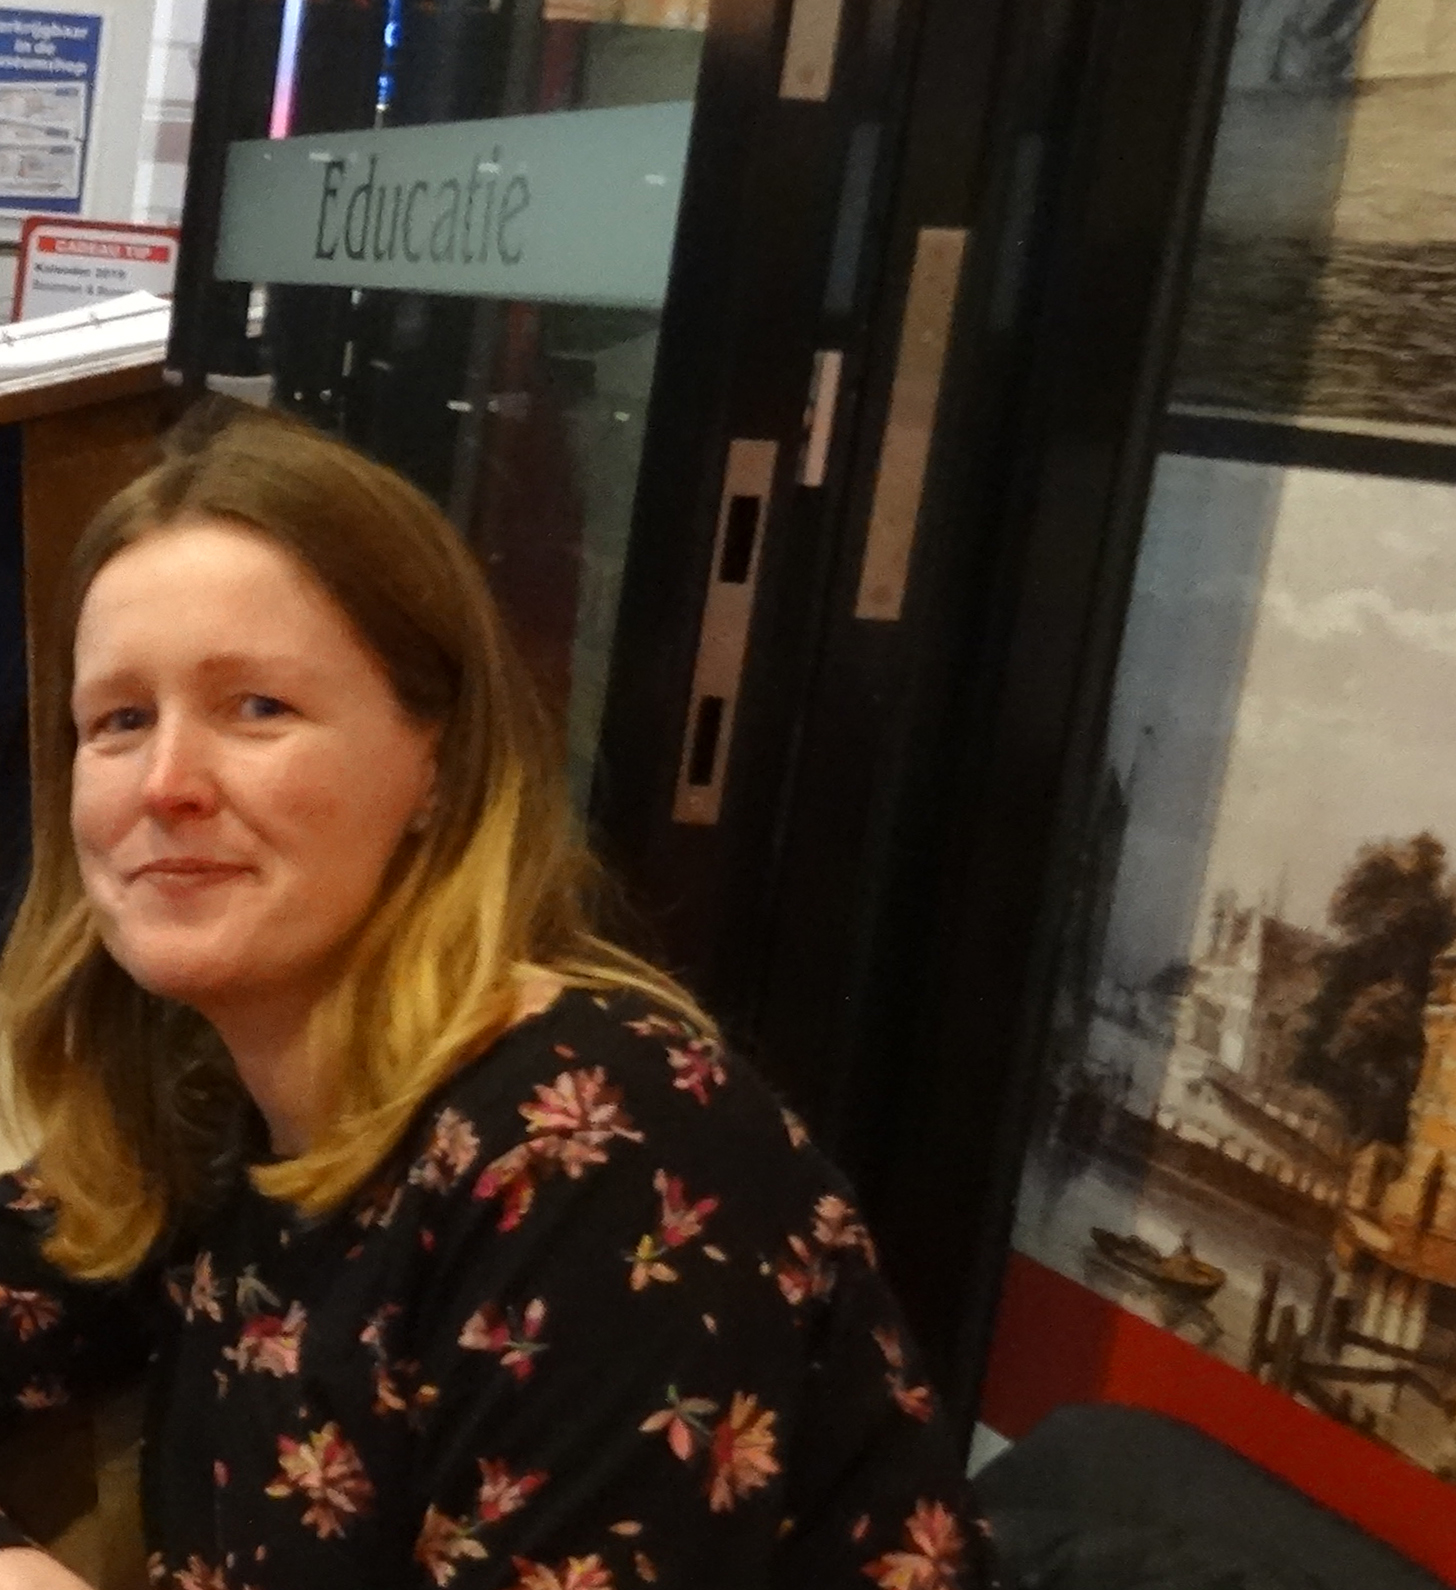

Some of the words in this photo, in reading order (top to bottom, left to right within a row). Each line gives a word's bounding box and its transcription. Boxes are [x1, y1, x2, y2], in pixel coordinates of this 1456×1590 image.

[13, 38, 32, 54] in
[33, 40, 57, 55] de
[314, 144, 531, 266] Educatie
[125, 244, 152, 260] TIP
